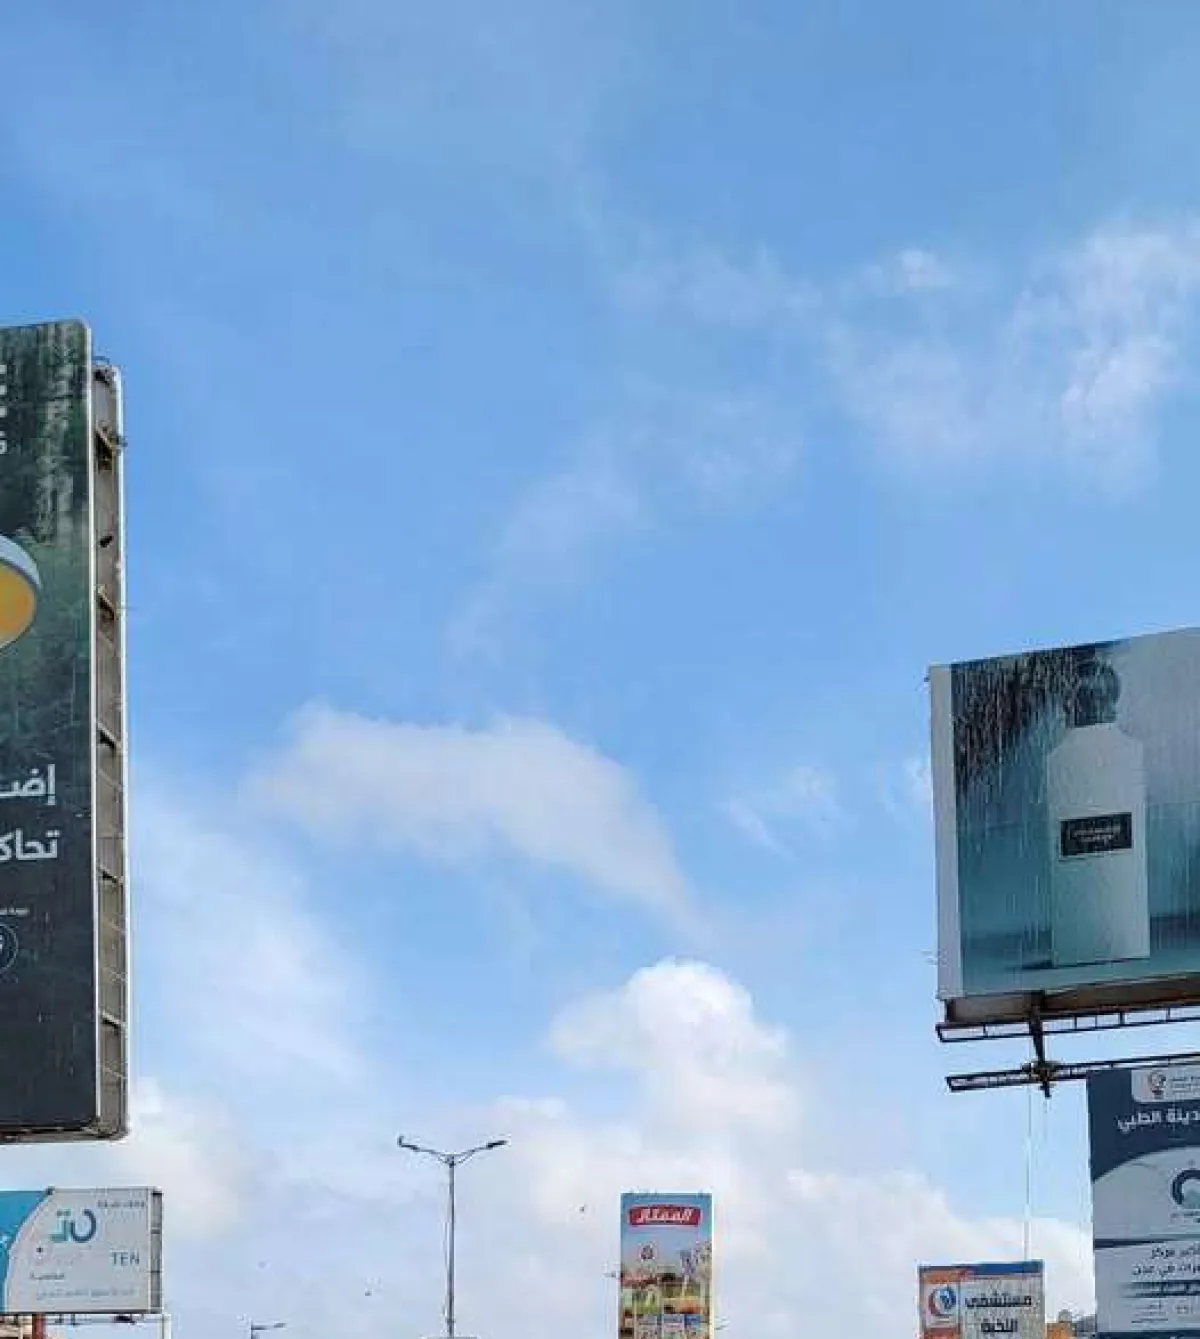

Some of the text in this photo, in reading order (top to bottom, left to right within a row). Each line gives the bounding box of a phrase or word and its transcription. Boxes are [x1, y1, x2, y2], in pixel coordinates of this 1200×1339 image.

[0, 828, 60, 862] تحاك
[1117, 1107, 1200, 1135] دينة الطبي
[111, 1251, 140, 1266] TEN
[965, 1290, 1032, 1308] مستشفى
[980, 1317, 1018, 1333] النخبة
